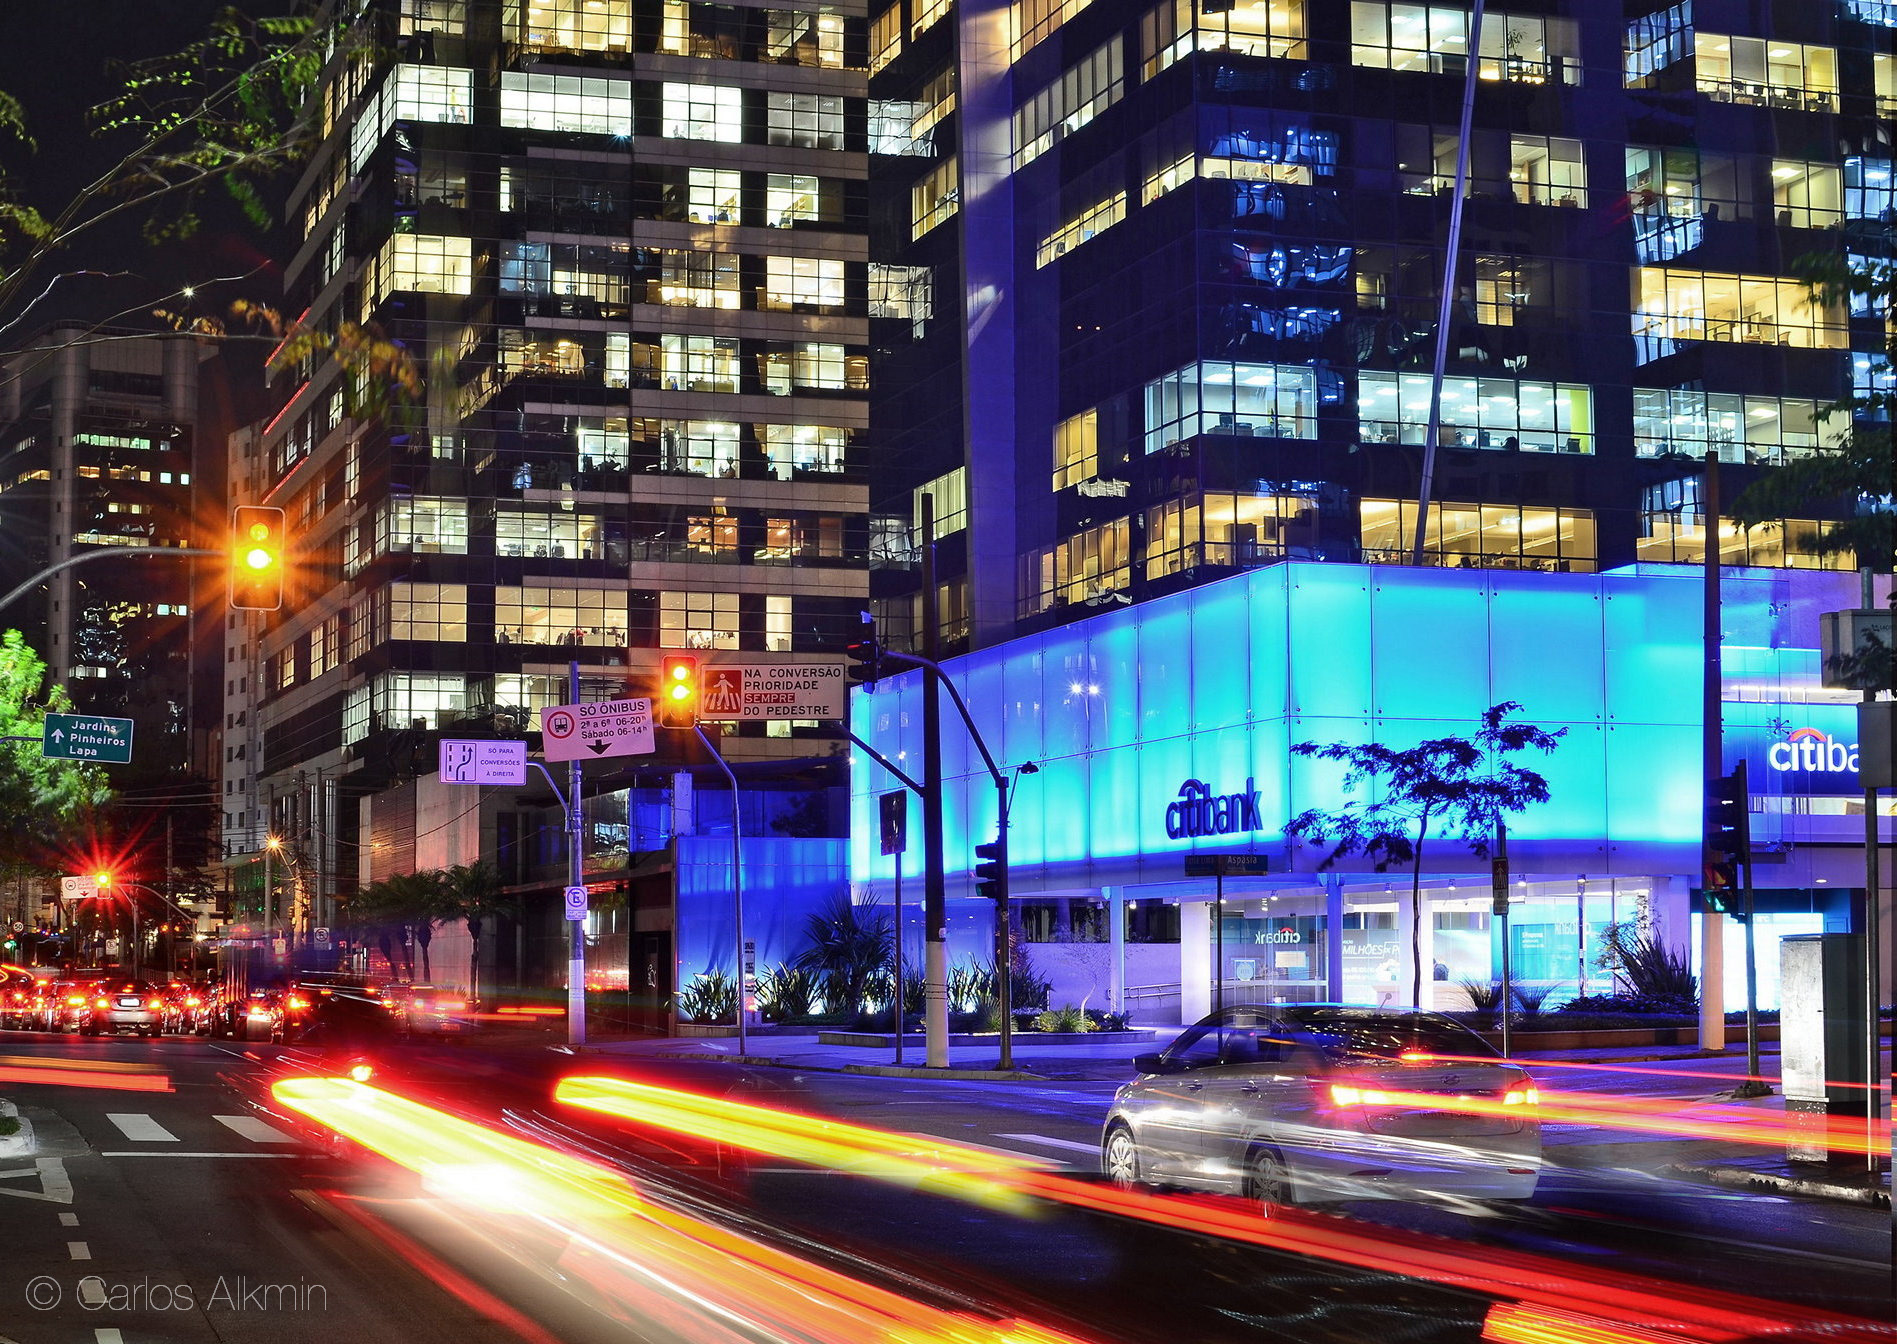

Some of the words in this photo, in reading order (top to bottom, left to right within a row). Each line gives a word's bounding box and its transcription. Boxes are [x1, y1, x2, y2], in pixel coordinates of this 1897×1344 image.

[744, 669, 762, 678] NA
[769, 666, 840, 678] CONVERSÃO
[744, 681, 818, 690] PRIORIDADE
[745, 693, 795, 703] SEMPRE
[579, 704, 597, 717] SÓ
[600, 702, 645, 715] ÔNIBUS
[744, 706, 760, 715] DO
[766, 706, 830, 715] PEDESTRE
[71, 720, 117, 733] Jardins
[70, 733, 126, 747] Pinheiros
[581, 728, 615, 740] Sábado
[69, 745, 97, 756] Lapa
[1769, 733, 1859, 773] citiba
[1165, 777, 1263, 840] citibank
[14, 923, 23, 931] 50
[1342, 943, 1383, 955] MILHÕES
